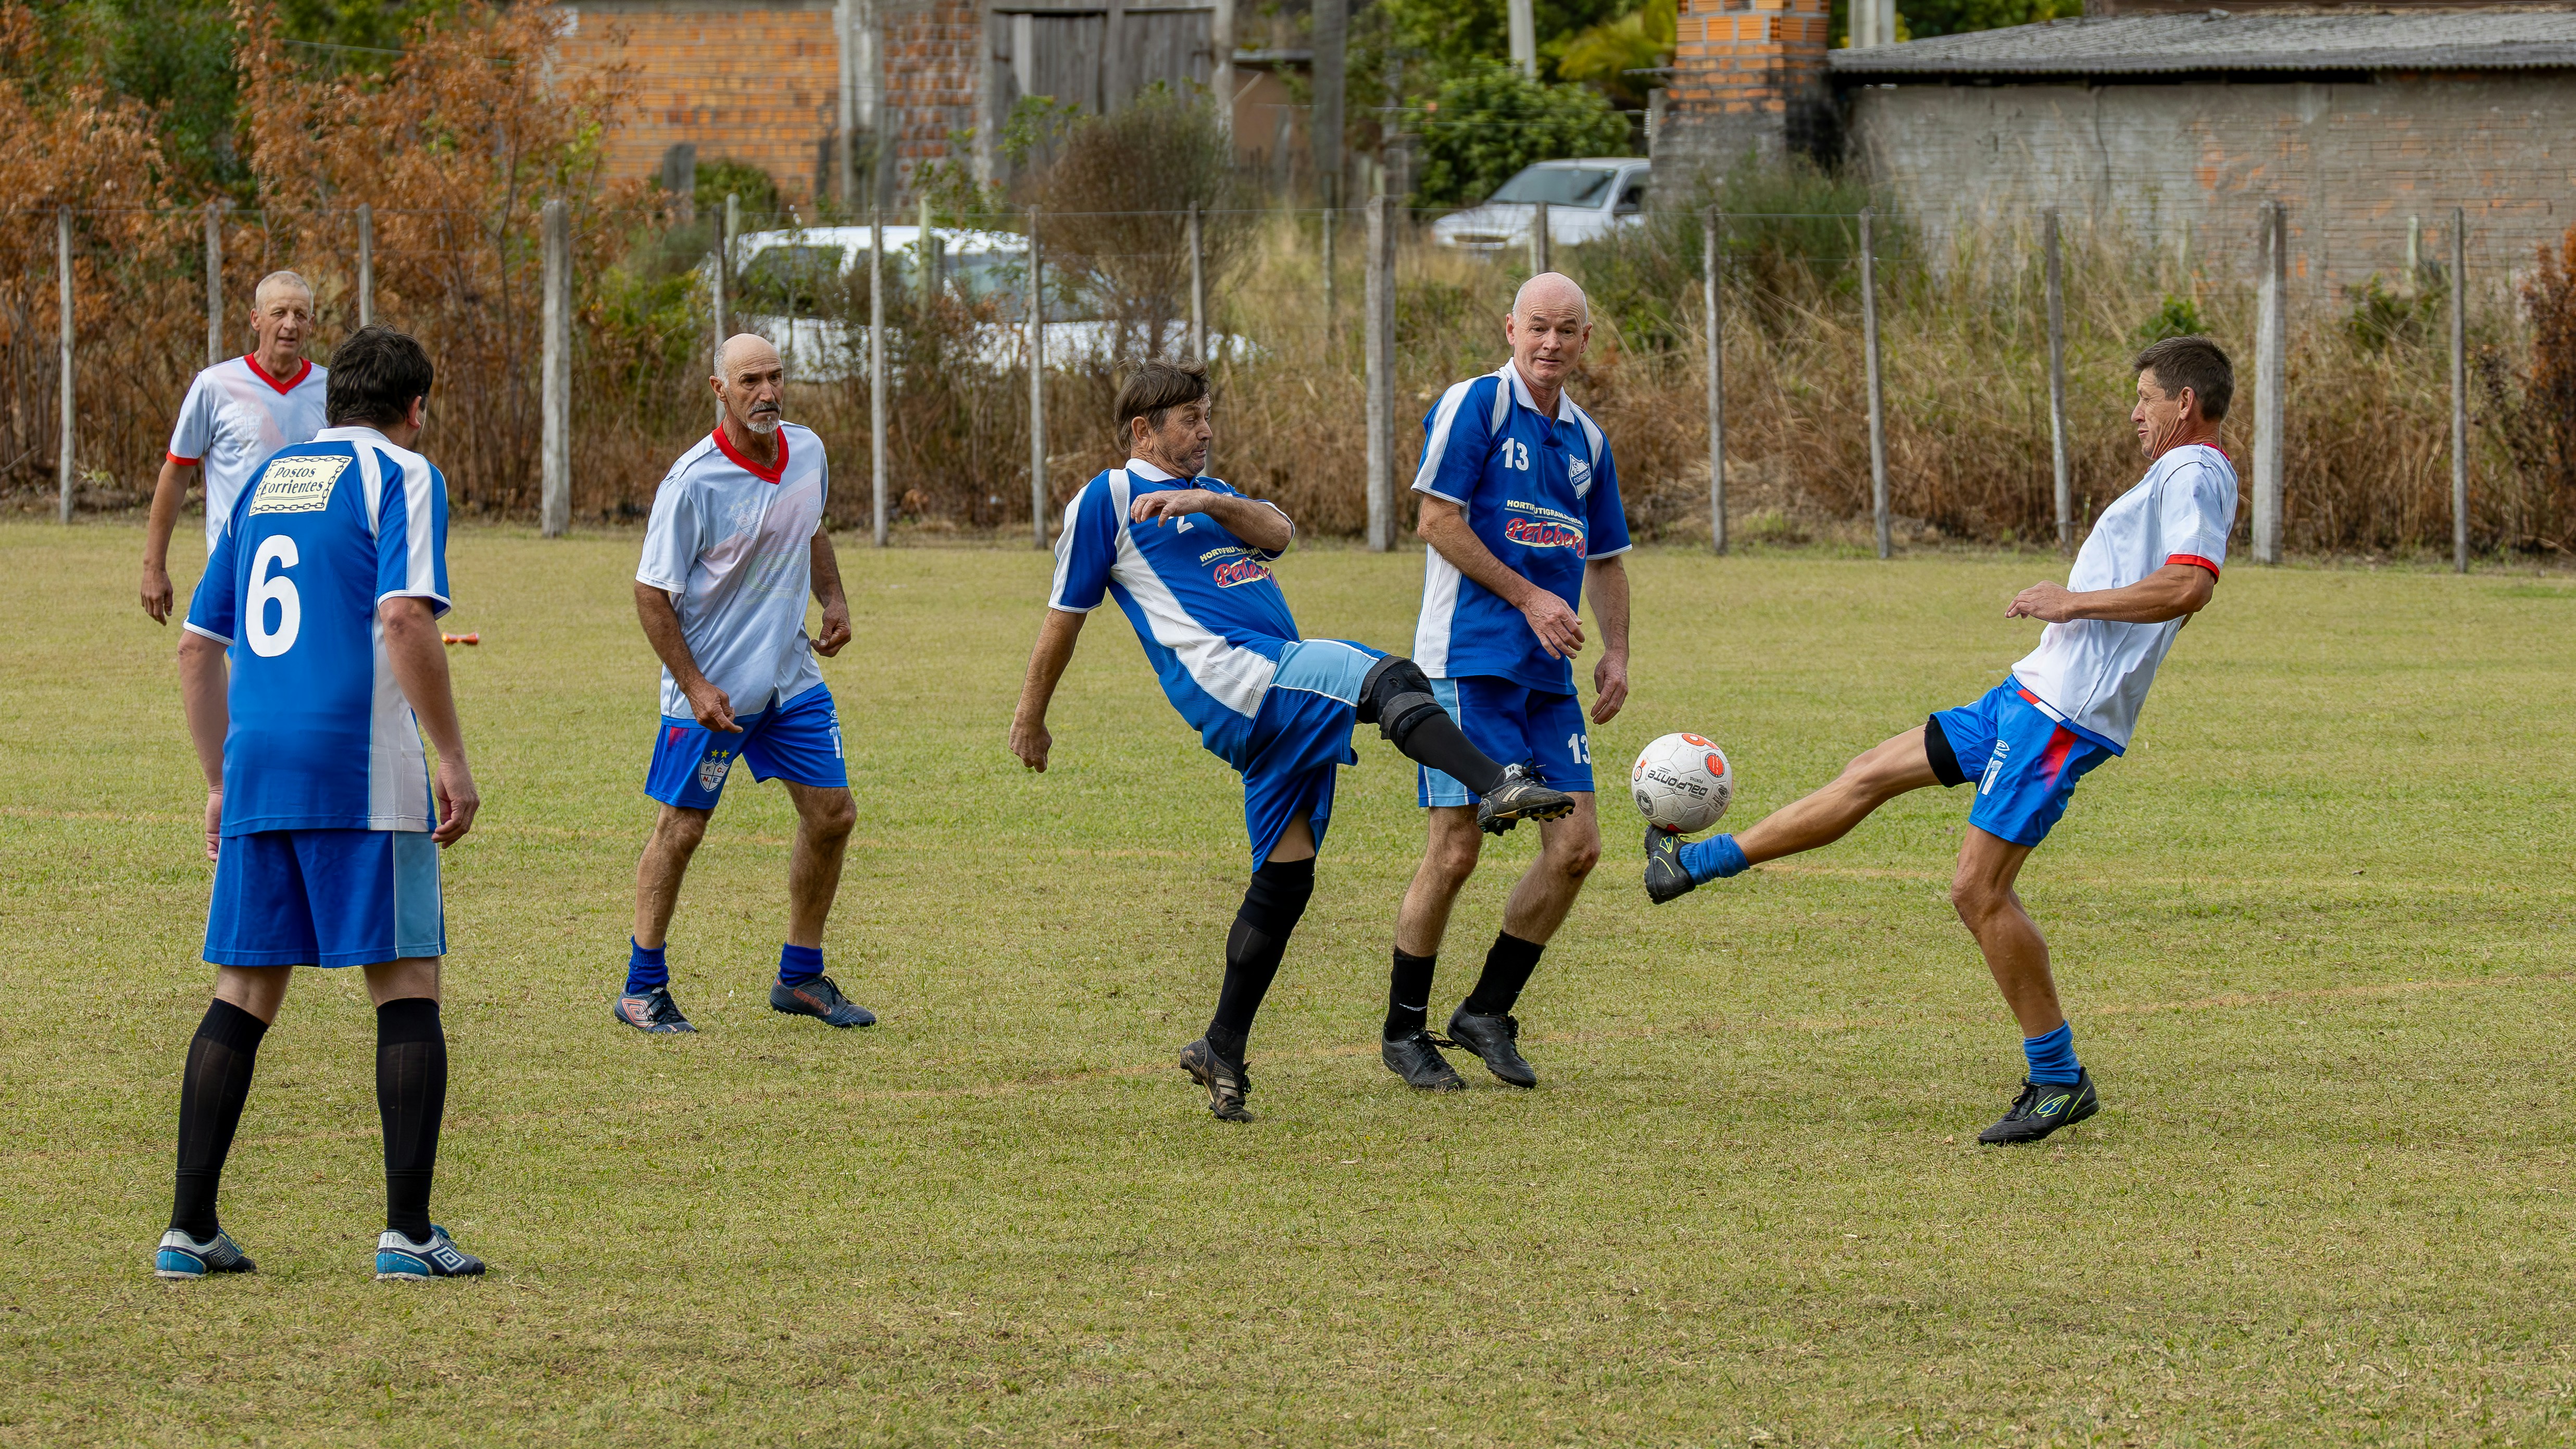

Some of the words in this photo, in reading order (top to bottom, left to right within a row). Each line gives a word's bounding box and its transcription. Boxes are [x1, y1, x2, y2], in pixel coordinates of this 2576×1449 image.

[1502, 438, 1529, 471] 13
[260, 480, 324, 497] Corrientes
[274, 467, 316, 478] Postos
[1506, 518, 1586, 558] Perleberg
[245, 534, 301, 657] 6
[1568, 733, 1591, 764] 13
